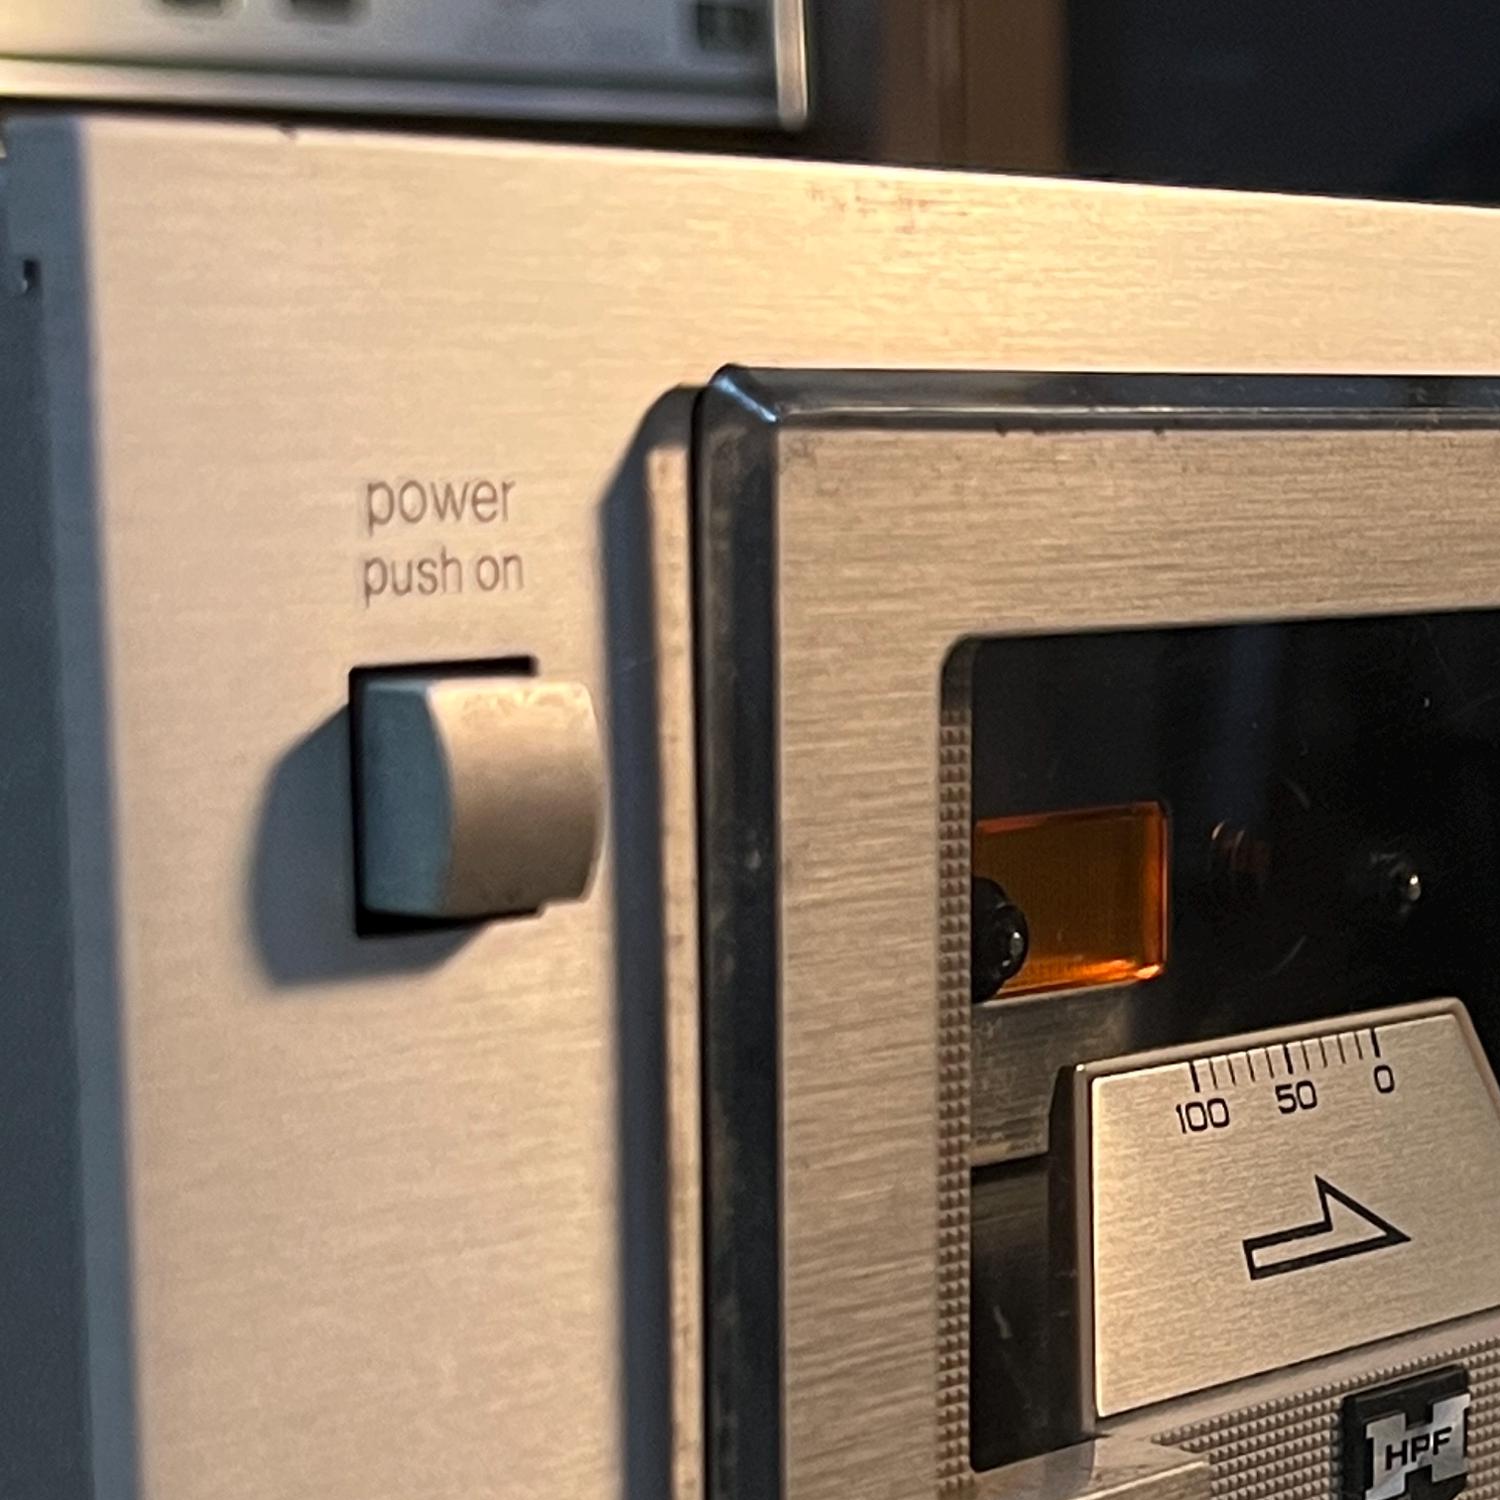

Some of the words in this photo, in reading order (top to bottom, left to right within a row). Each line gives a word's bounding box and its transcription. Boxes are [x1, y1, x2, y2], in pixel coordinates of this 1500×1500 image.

[366, 480, 516, 536] power
[364, 546, 463, 608] push
[476, 553, 524, 591] on
[1176, 1098, 1230, 1134] 100
[1275, 1080, 1317, 1114] 50
[1373, 1064, 1395, 1094] 0
[1385, 1426, 1452, 1471] HPF
